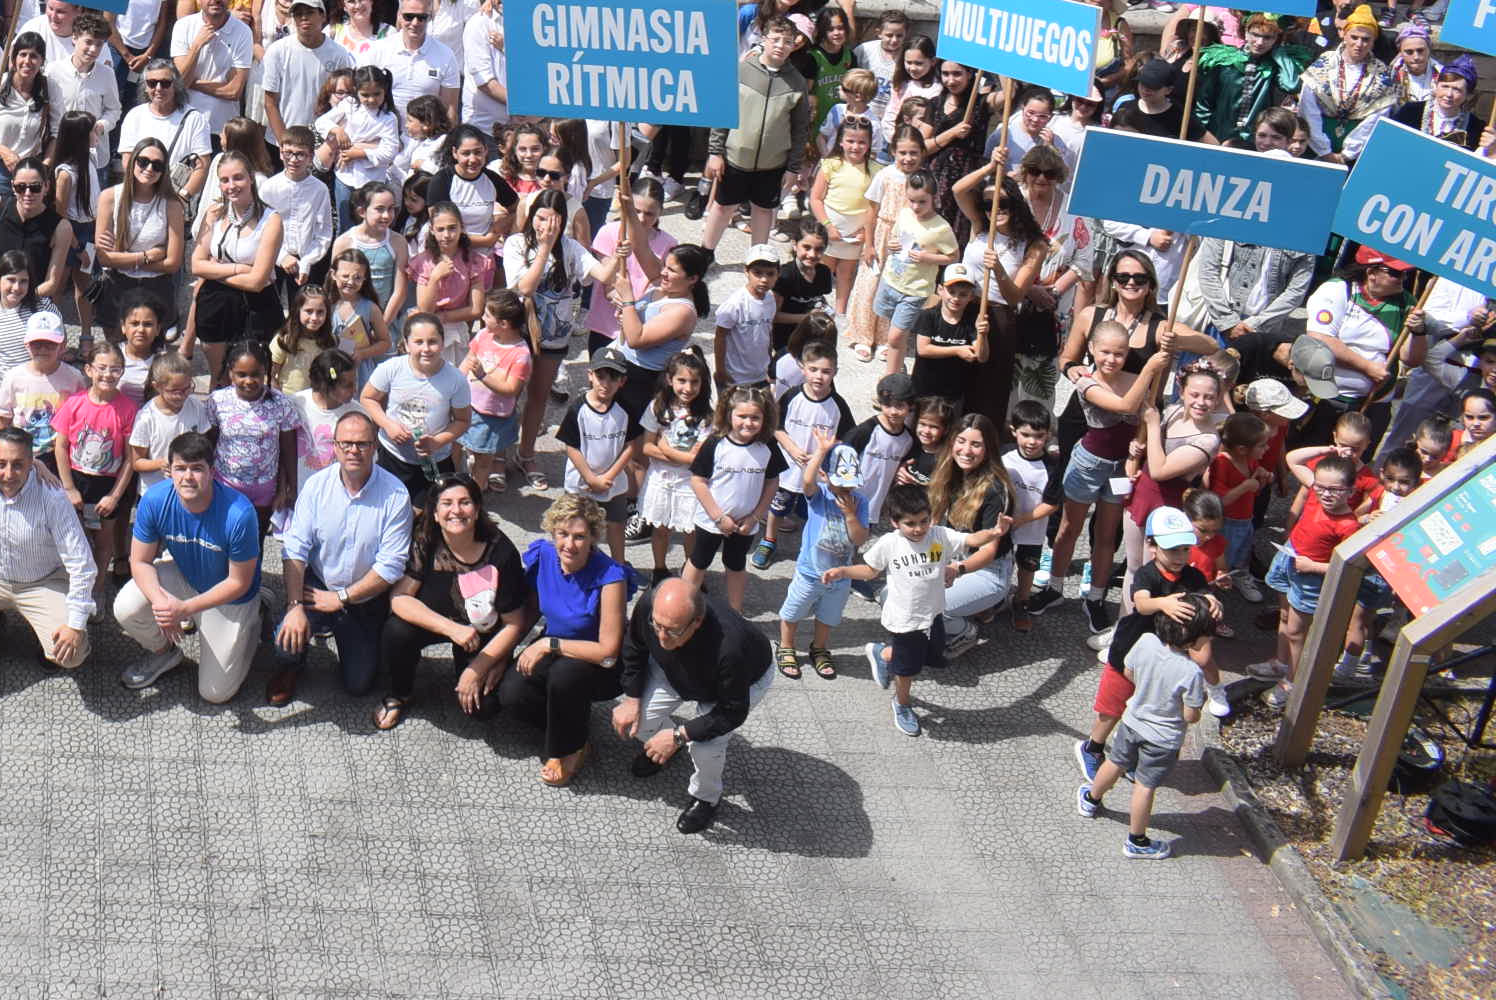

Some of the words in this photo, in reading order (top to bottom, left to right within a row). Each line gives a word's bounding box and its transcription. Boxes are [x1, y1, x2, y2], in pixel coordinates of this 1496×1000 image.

[532, 3, 710, 56] GIMNASIA
[547, 49, 699, 114] RÍTMICA
[1138, 163, 1273, 223] DANZA
[1435, 160, 1496, 226] TIR
[1357, 193, 1444, 257] CON
[1438, 228, 1496, 287] AR
